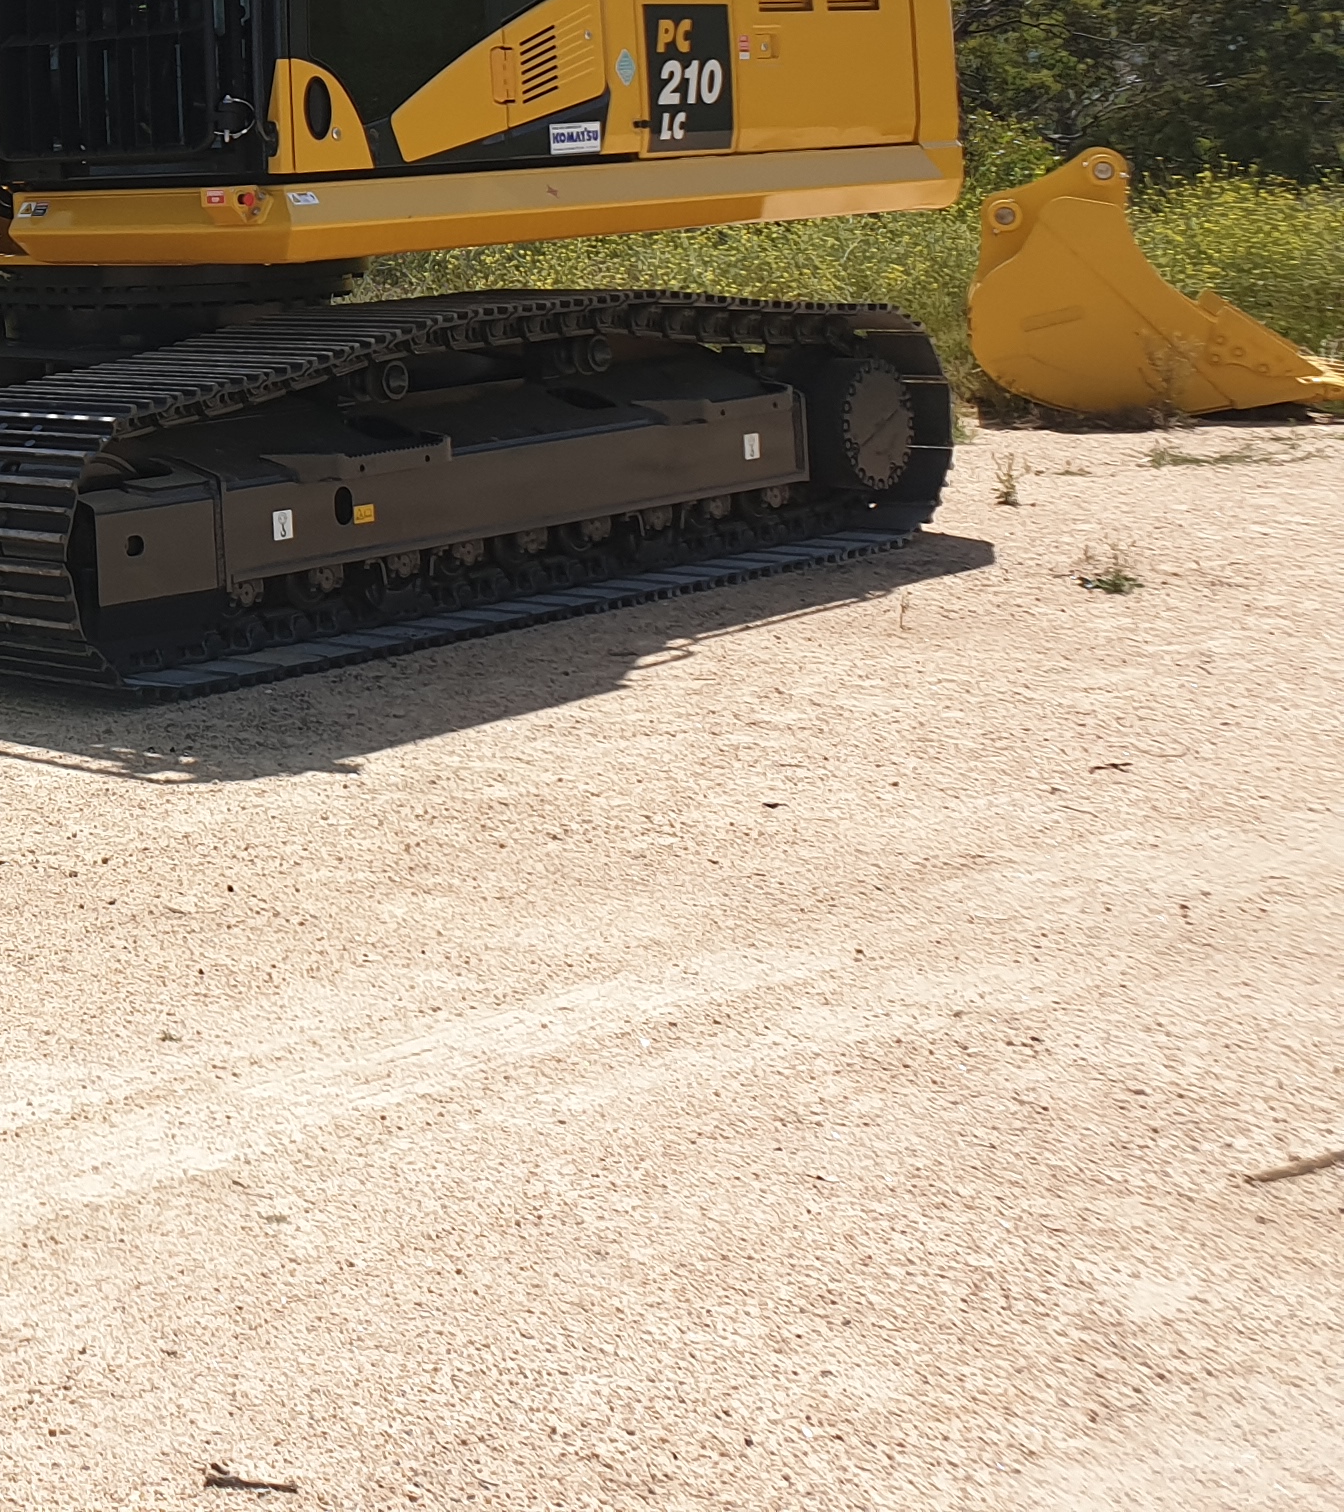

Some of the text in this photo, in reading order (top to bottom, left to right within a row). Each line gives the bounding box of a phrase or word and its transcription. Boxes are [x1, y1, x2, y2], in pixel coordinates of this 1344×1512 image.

[656, 18, 693, 54] PC
[657, 58, 723, 105] 210
[552, 127, 599, 144] KOMATSU
[659, 111, 687, 140] LC
